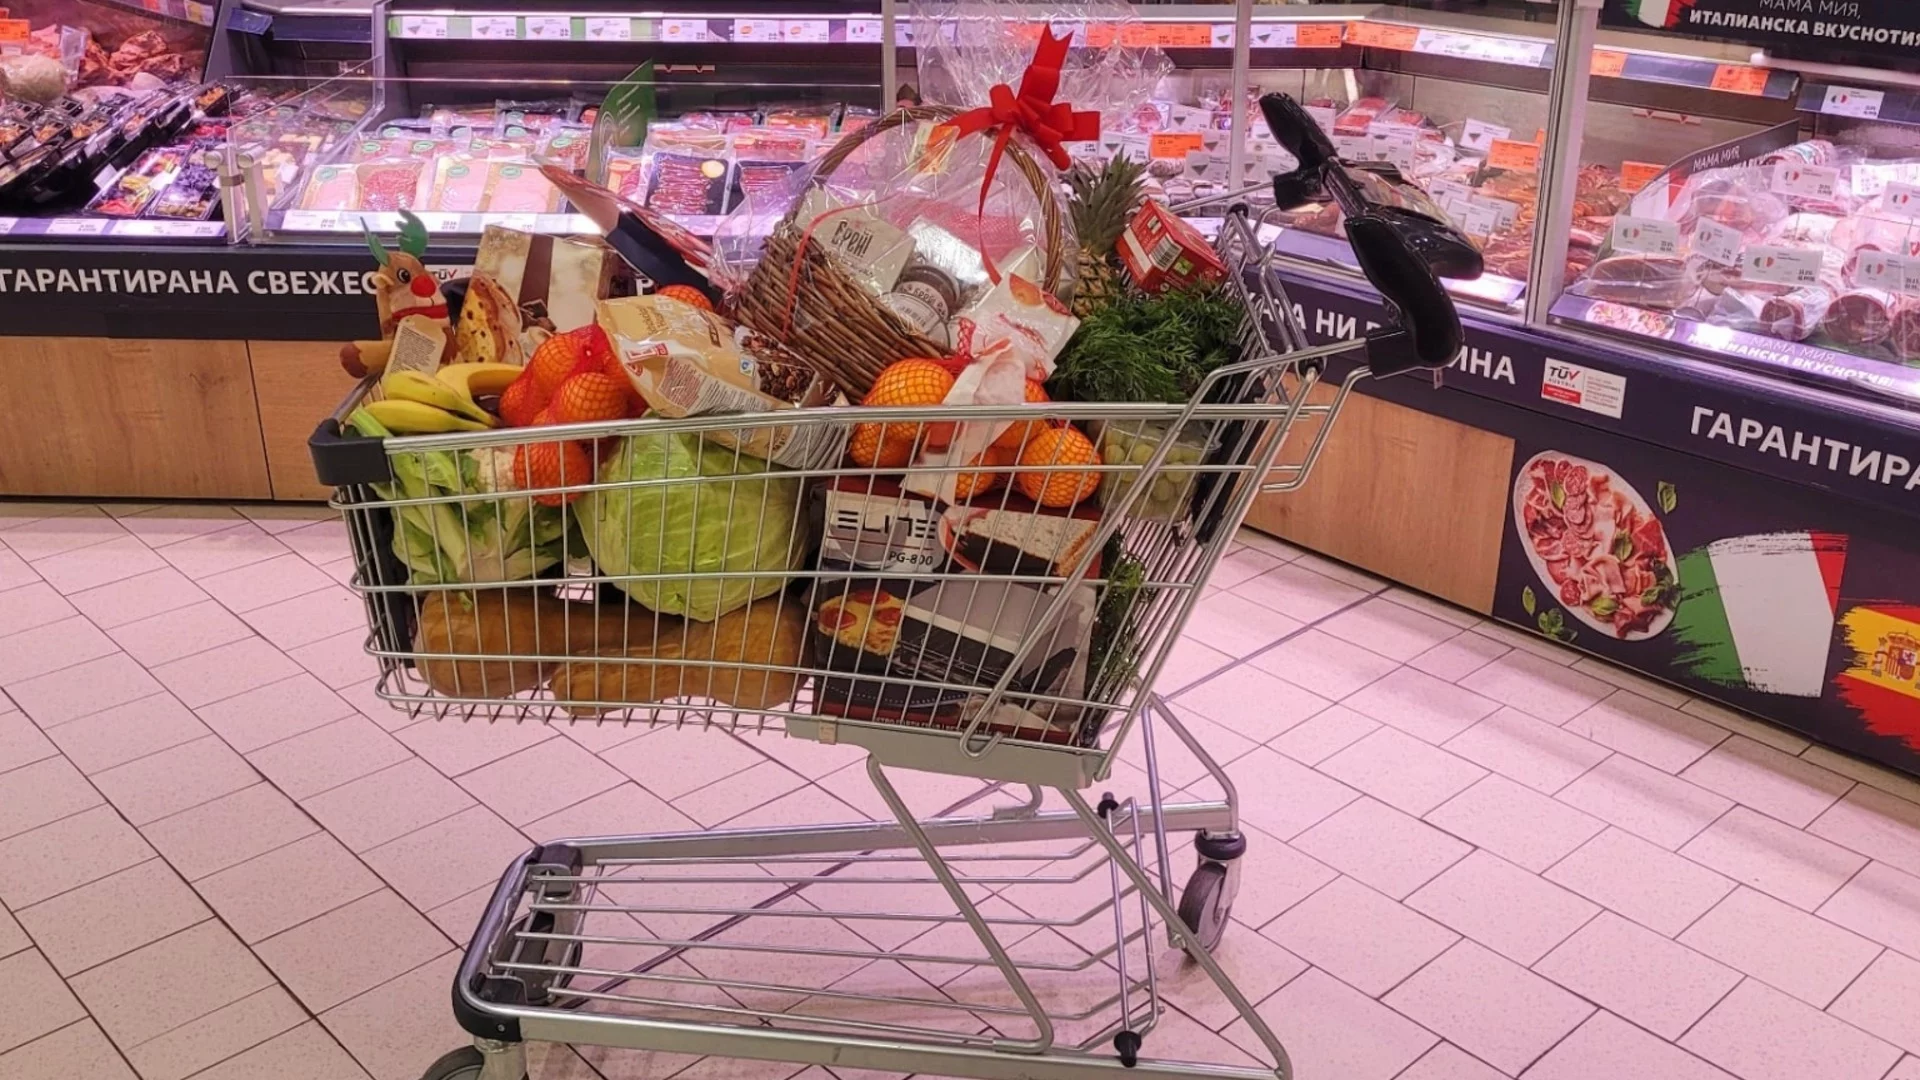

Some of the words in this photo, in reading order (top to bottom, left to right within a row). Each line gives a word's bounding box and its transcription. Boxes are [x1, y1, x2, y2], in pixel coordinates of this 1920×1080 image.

[1759, 0, 1814, 14] МАМА
[1818, 0, 1861, 20] МИЯ,
[1690, 9, 1810, 35] ИТАЛИАНСКА
[0, 268, 240, 294] ГАРАНТИРАНА
[247, 269, 379, 295] СВЕЖЕС
[1315, 308, 1357, 340] НИ
[1751, 334, 1798, 353] МАМА
[1549, 366, 1581, 381] TÜV
[837, 509, 938, 539] ELITE
[889, 550, 935, 566] PG-800
